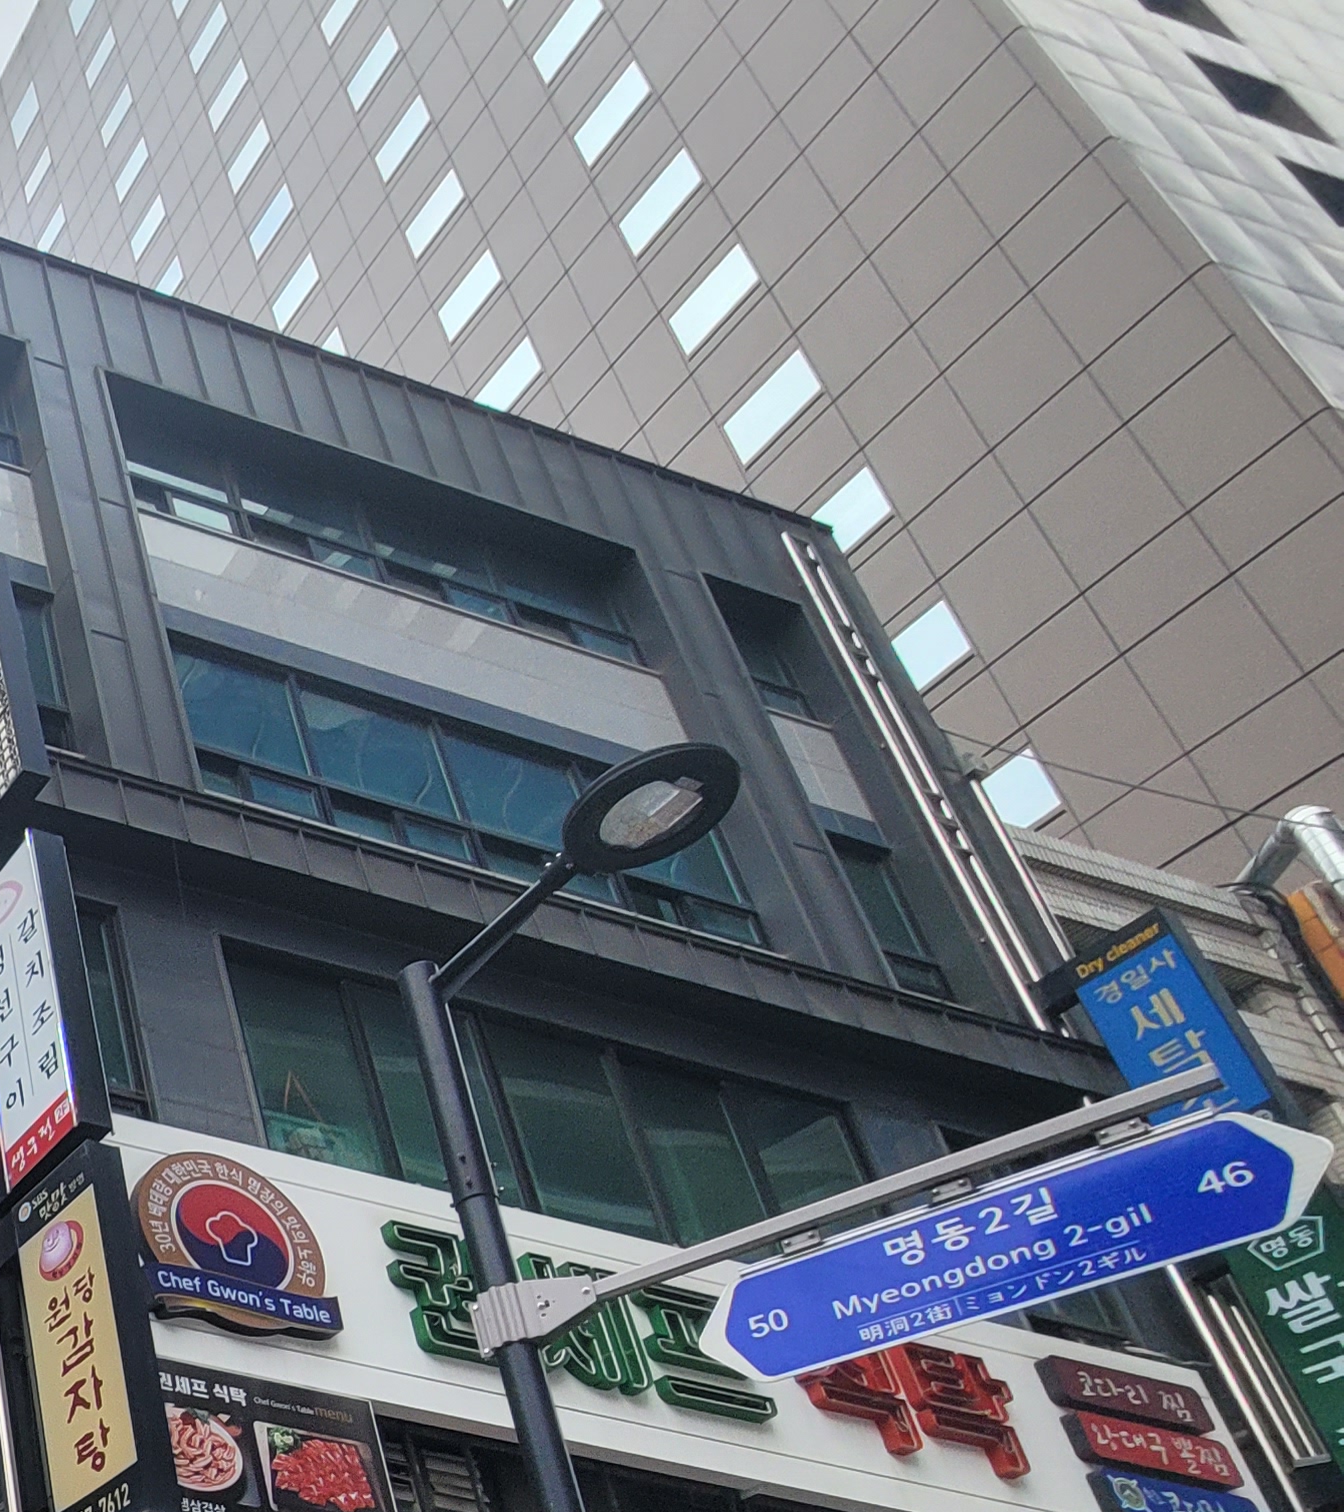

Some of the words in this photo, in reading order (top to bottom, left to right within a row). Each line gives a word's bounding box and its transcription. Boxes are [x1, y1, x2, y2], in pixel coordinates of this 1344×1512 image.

[1076, 958, 1104, 979] Dry
[1106, 923, 1160, 962] cleaner
[16, 907, 61, 1076] 갈치조림
[57, 1101, 69, 1120] 2F
[32, 1184, 48, 1209] SBS
[149, 1221, 175, 1253] 30년
[162, 1159, 214, 1185] 대한민국
[215, 1162, 243, 1185] 한식
[248, 1177, 288, 1216] 명장의
[282, 1216, 309, 1243] 맛의
[297, 1246, 315, 1287] 노하우
[883, 1187, 1059, 1266] 명동2길
[1197, 1160, 1255, 1194] 46
[1260, 1224, 1315, 1258] 명동
[157, 1270, 201, 1293] Chef
[207, 1281, 276, 1312] Gwon's
[279, 1300, 331, 1323] Table
[748, 1310, 789, 1338] 50
[831, 1240, 1056, 1320] Myeongdong
[1063, 1203, 1154, 1248] 2-gil
[859, 1305, 952, 1344] 明洞2街
[964, 1247, 1147, 1314] ミョンドン2ギル
[212, 1383, 247, 1407] 식탁
[314, 1406, 353, 1423] menu
[1077, 1371, 1149, 1405] 코다리
[1158, 1390, 1195, 1422] 찜
[1090, 1422, 1169, 1465] 왕대구
